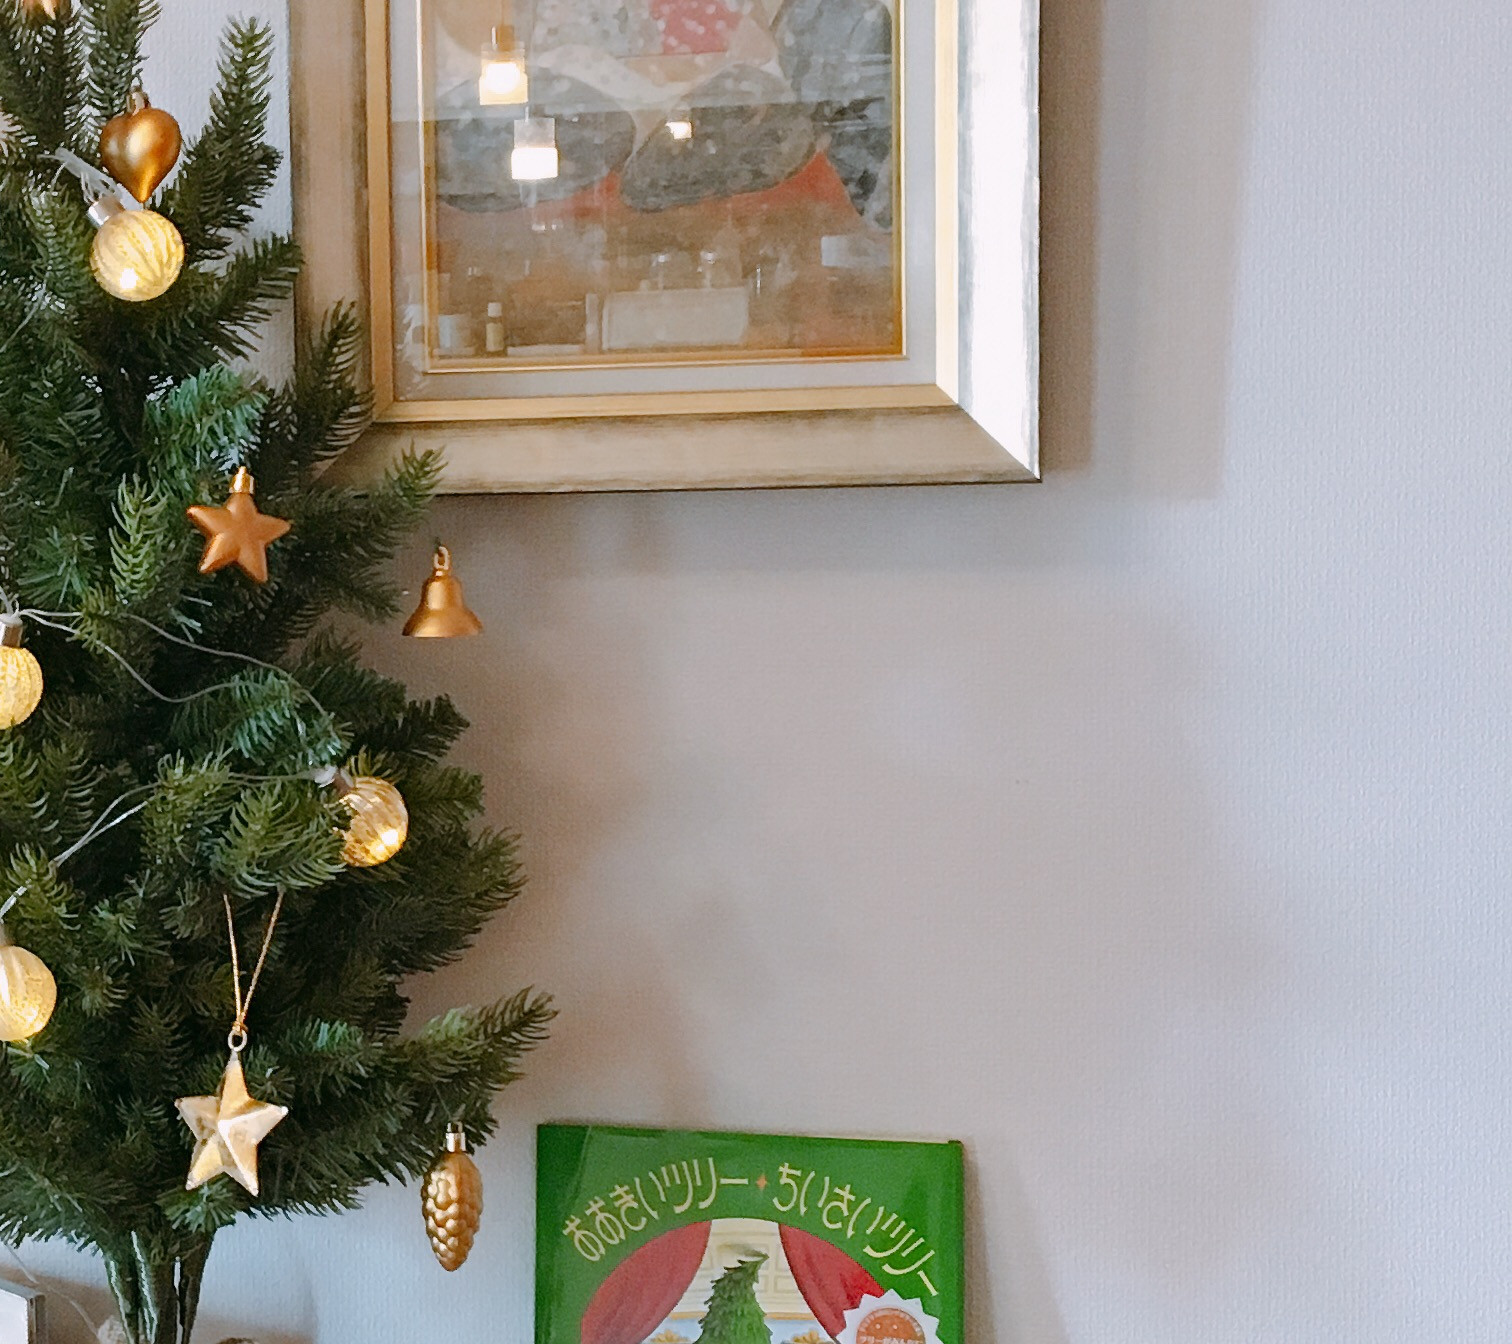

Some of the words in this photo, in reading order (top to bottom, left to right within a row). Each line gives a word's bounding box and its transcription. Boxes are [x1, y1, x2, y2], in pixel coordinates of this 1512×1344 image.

[562, 1158, 750, 1263] おおきいツリー
[772, 1163, 939, 1297] ちいさいツリー
